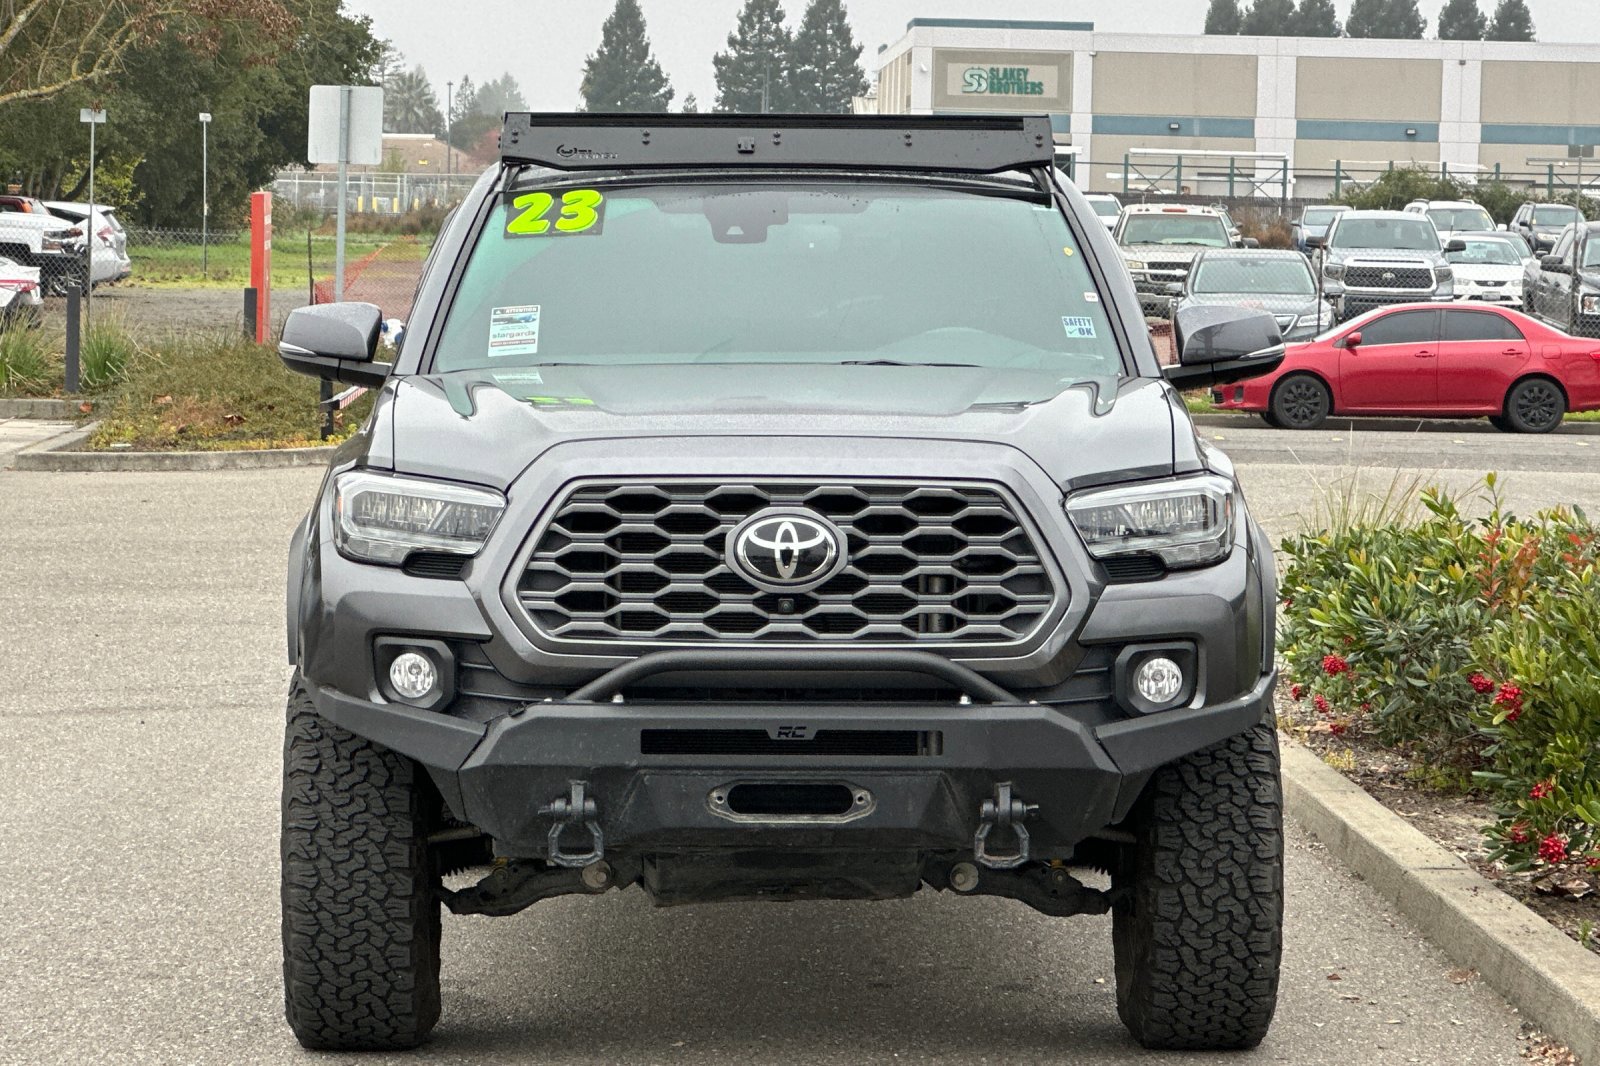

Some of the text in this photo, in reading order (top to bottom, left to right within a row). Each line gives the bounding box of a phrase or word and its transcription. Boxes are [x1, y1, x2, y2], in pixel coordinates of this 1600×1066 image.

[989, 67, 1029, 81] SLAKEY
[989, 81, 1044, 95] BROTHERS
[507, 189, 603, 234] 23
[1063, 317, 1091, 326] SAFETY
[1078, 327, 1093, 335] OK
[777, 726, 807, 738] RC
